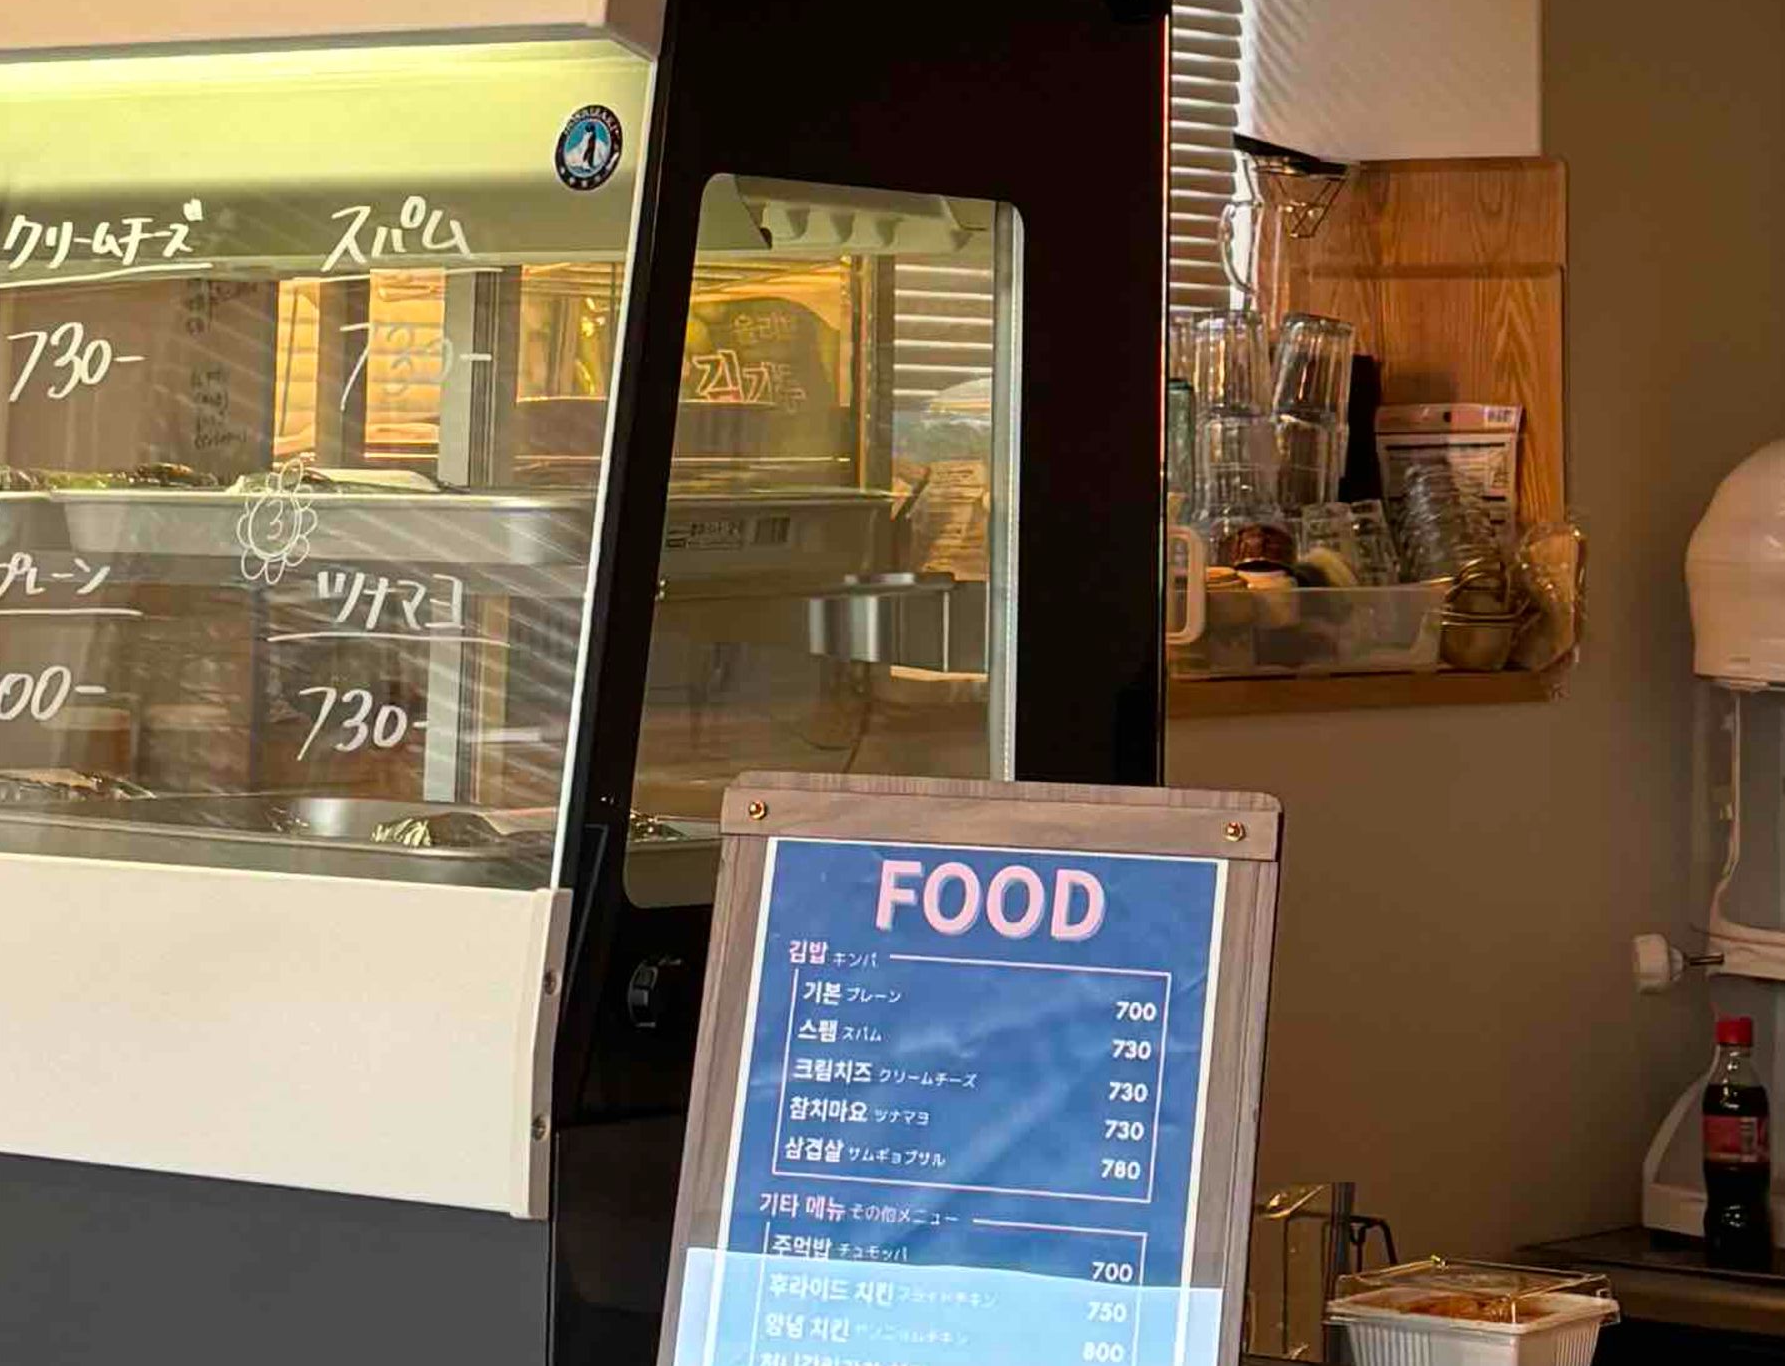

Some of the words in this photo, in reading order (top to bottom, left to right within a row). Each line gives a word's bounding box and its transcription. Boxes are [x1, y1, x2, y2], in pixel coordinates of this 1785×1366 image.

[2, 199, 203, 271] クリームチーズ
[320, 195, 473, 272] スパム
[316, 570, 466, 631] ツナマヨ
[874, 860, 1107, 943] FOOD
[788, 940, 829, 966] 김밥
[802, 980, 843, 1007] 기본
[1115, 1001, 1158, 1023] 700
[798, 1019, 839, 1044] 스팸
[1112, 1039, 1153, 1061] 730
[792, 1058, 873, 1085] 크림치즈
[878, 1068, 979, 1089] クリームチーズ
[1108, 1081, 1149, 1103] 730
[788, 1096, 869, 1123] 참치마요
[1104, 1120, 1145, 1141] 730
[784, 1137, 845, 1164] 삼겹살
[1100, 1159, 1141, 1181] 780
[759, 1192, 800, 1218] 기타
[805, 1197, 847, 1222] 메뉴
[850, 1204, 960, 1226] その他メニュー
[771, 1235, 833, 1262] 주먹밥
[1092, 1261, 1134, 1282] 700
[1087, 1301, 1127, 1324] 750
[1082, 1341, 1125, 1364] 800
